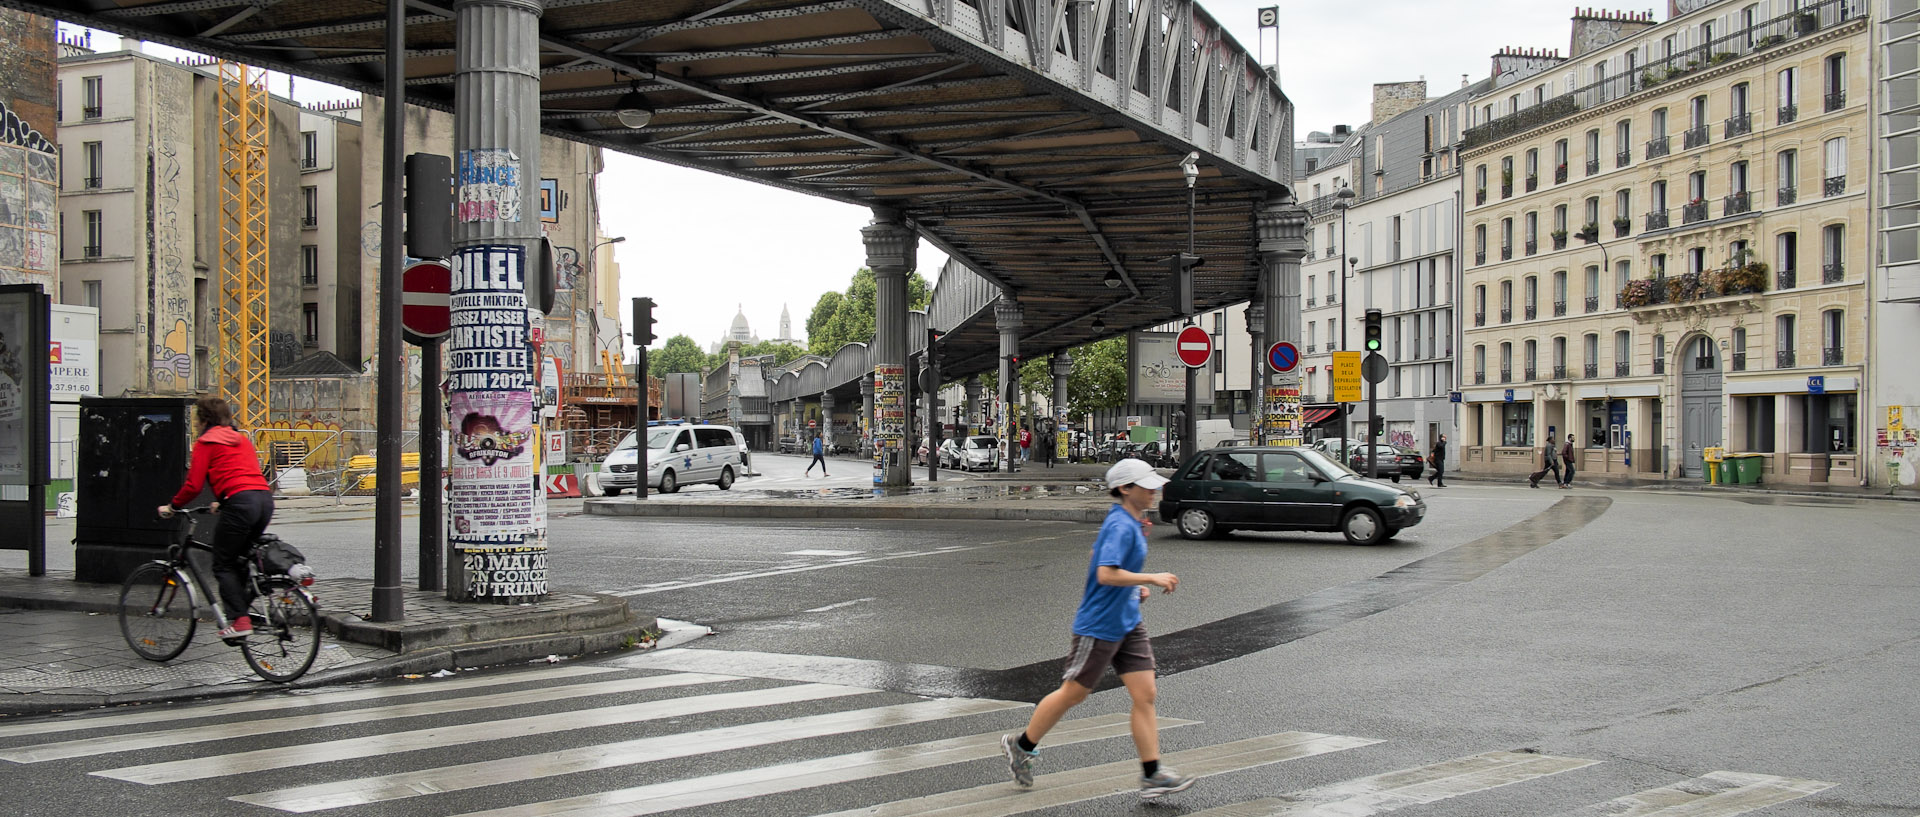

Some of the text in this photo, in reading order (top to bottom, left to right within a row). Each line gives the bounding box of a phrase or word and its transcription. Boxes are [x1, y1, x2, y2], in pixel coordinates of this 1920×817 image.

[458, 200, 497, 221] NOUS
[450, 252, 524, 291] BILEL
[483, 294, 524, 308] MIXTAPE
[481, 311, 524, 325] PASSER
[450, 325, 525, 349] L'ARTISTE
[450, 351, 525, 368] SORTIE LE
[449, 372, 525, 390] 25 JUIN 2012
[495, 465, 501, 479] LE
[503, 465, 508, 478] 9
[510, 465, 531, 478] JUILLET
[464, 554, 484, 571] 20
[487, 555, 531, 571] MAI
